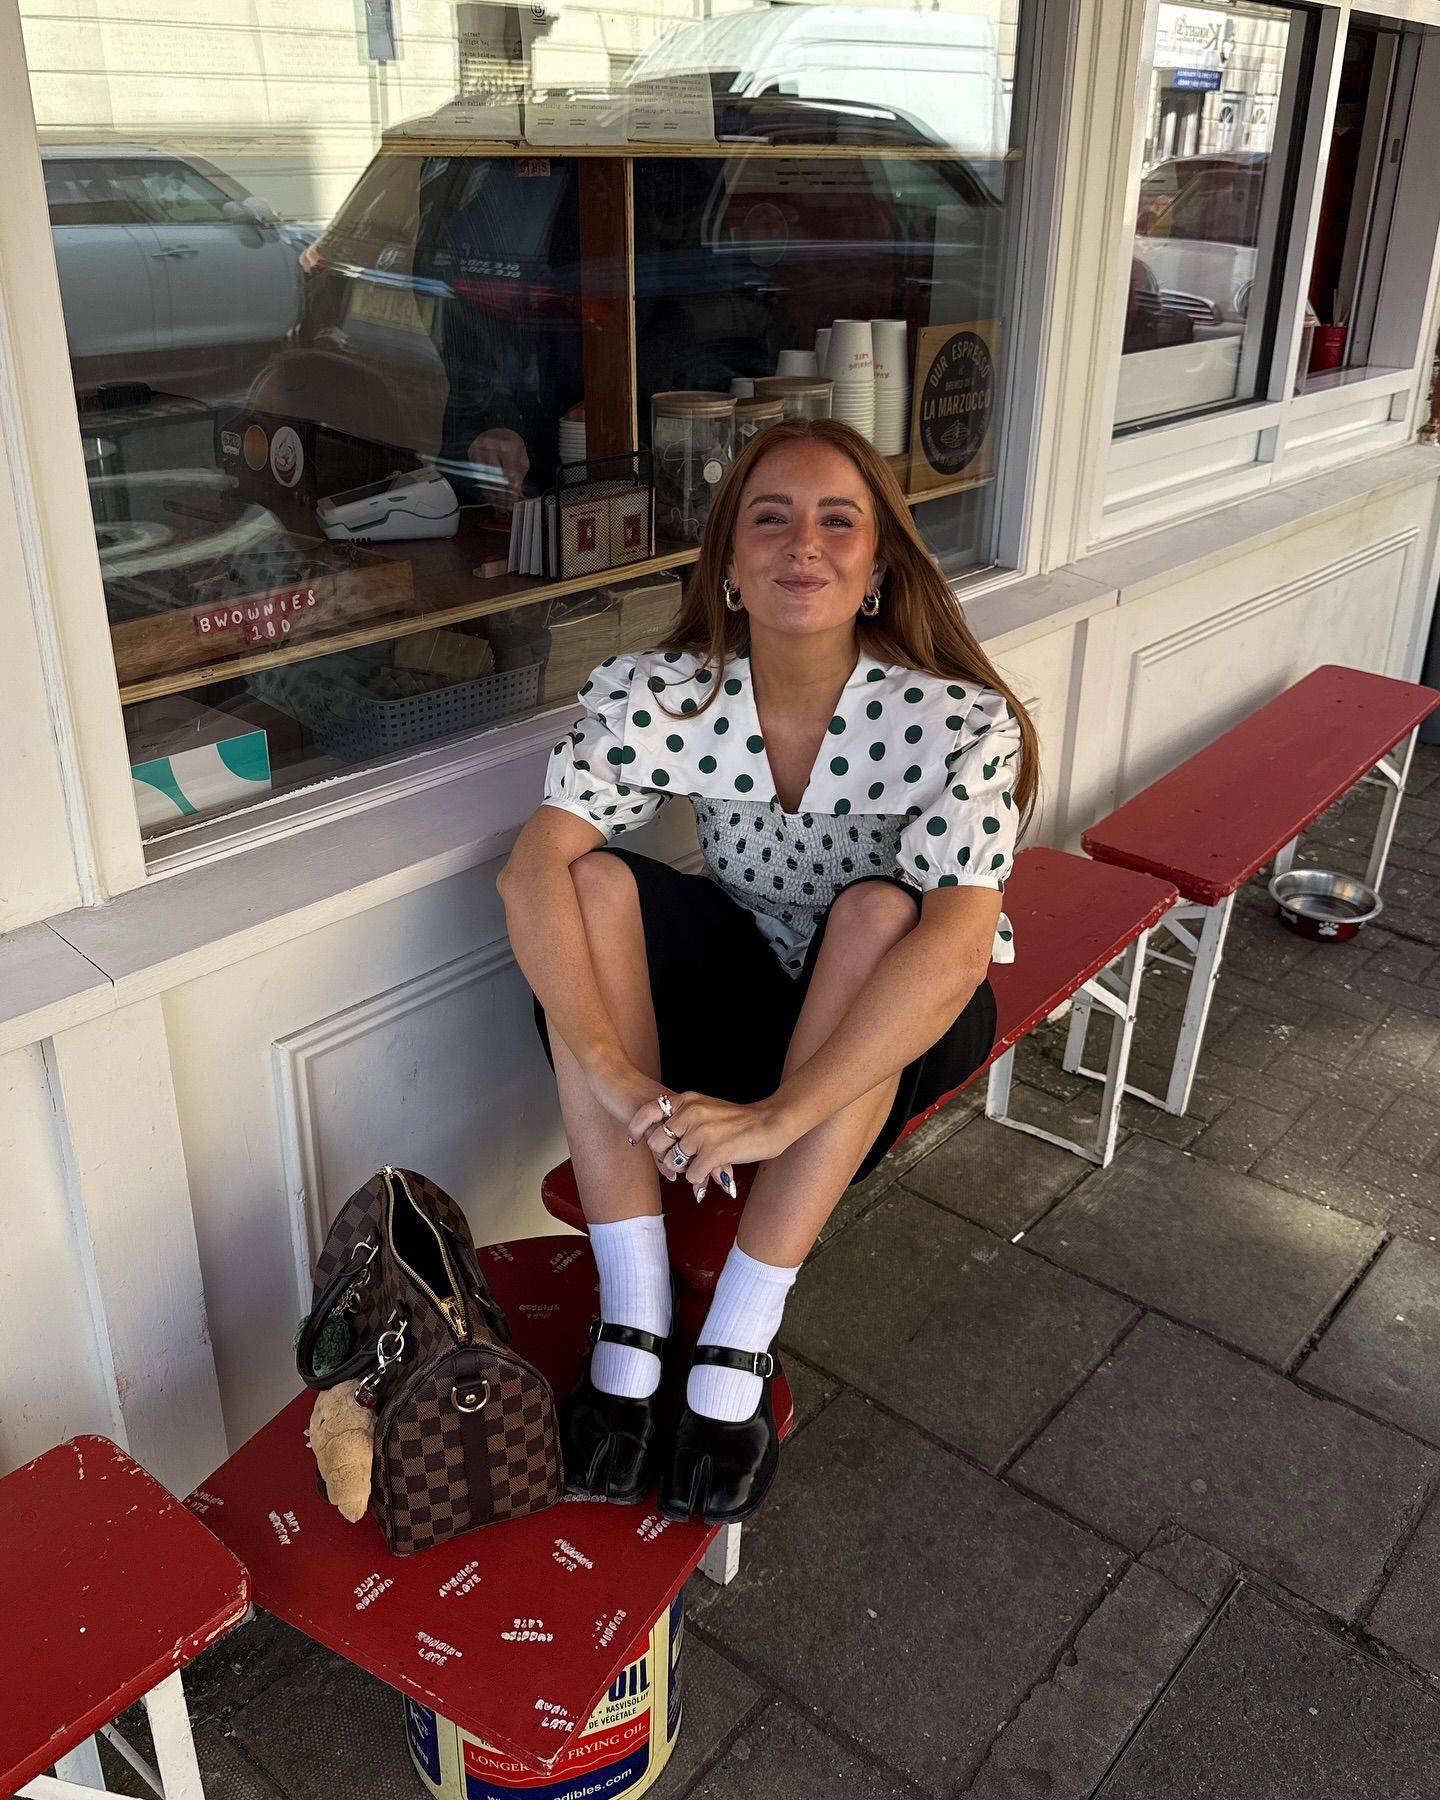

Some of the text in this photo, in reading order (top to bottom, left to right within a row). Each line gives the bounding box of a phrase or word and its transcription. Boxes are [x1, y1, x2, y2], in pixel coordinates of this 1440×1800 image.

[930, 341, 990, 387] OUR ESPRESSO
[923, 388, 991, 421] LA MARZOCCO
[200, 589, 316, 633] BWOWNIES
[567, 1736, 621, 1761] FRYING
[623, 1724, 647, 1741] OIL
